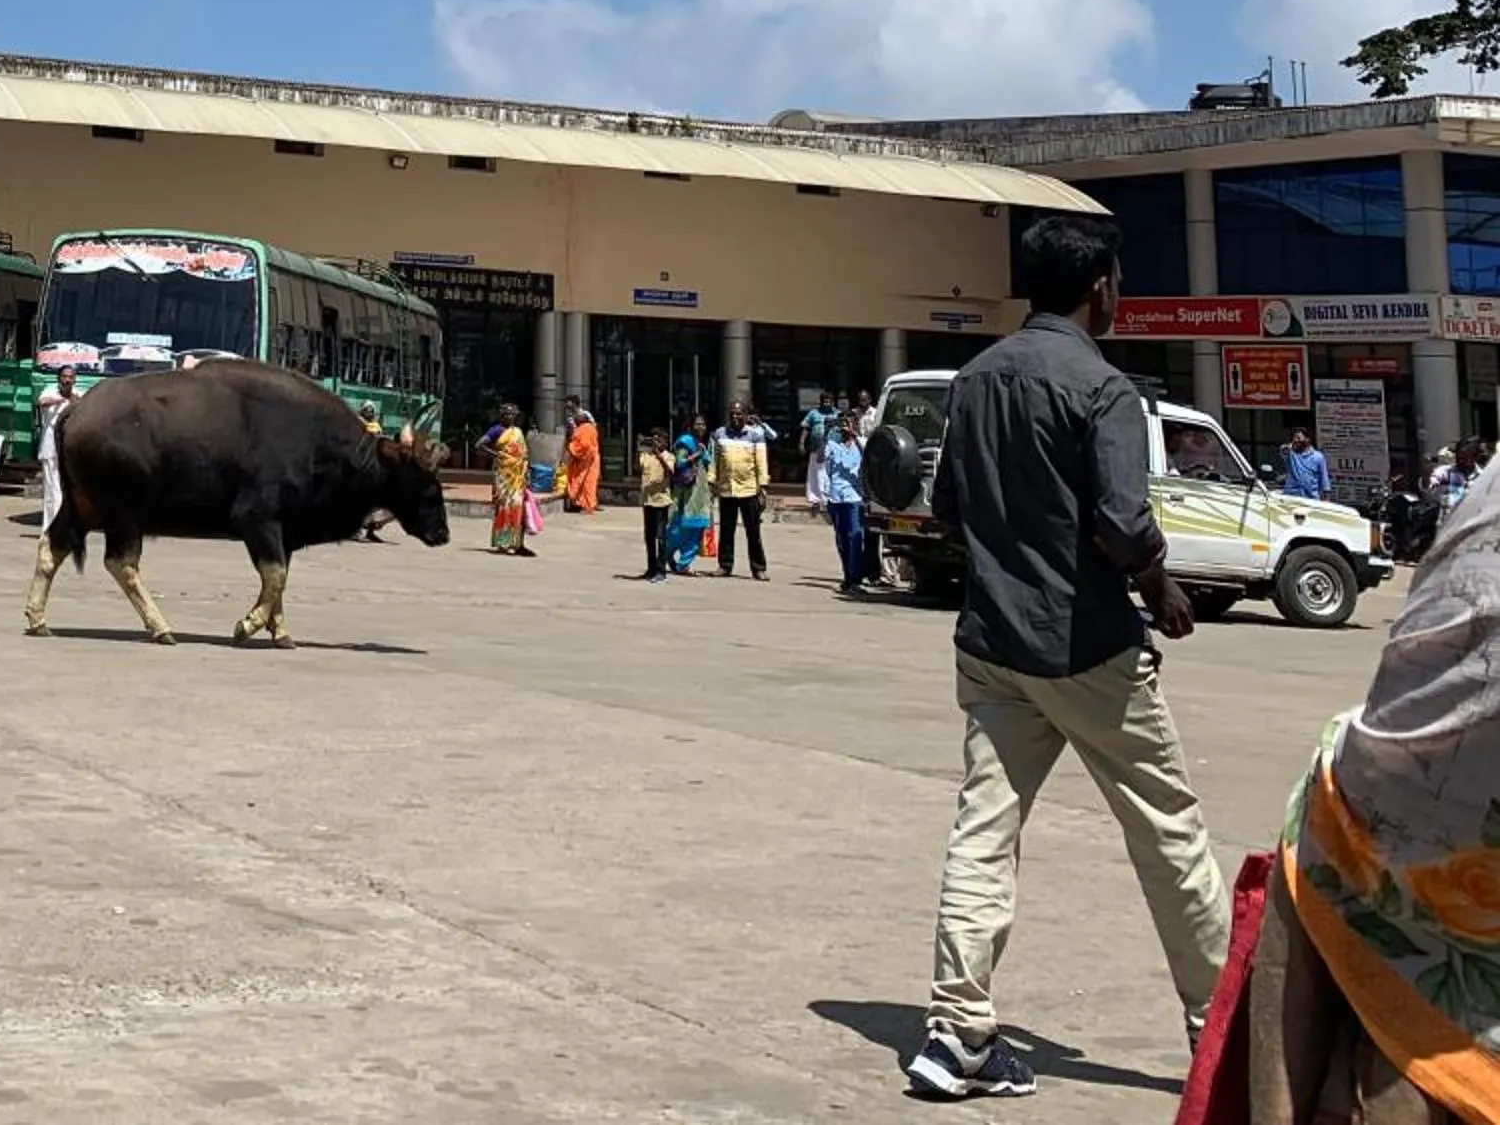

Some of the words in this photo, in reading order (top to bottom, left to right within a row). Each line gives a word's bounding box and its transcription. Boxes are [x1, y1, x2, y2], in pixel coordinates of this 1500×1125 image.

[1177, 307, 1242, 325] SuperNet
[1303, 303, 1348, 320] DIGITAL
[1352, 303, 1379, 319] SEVA
[1382, 302, 1429, 318] KENDRA
